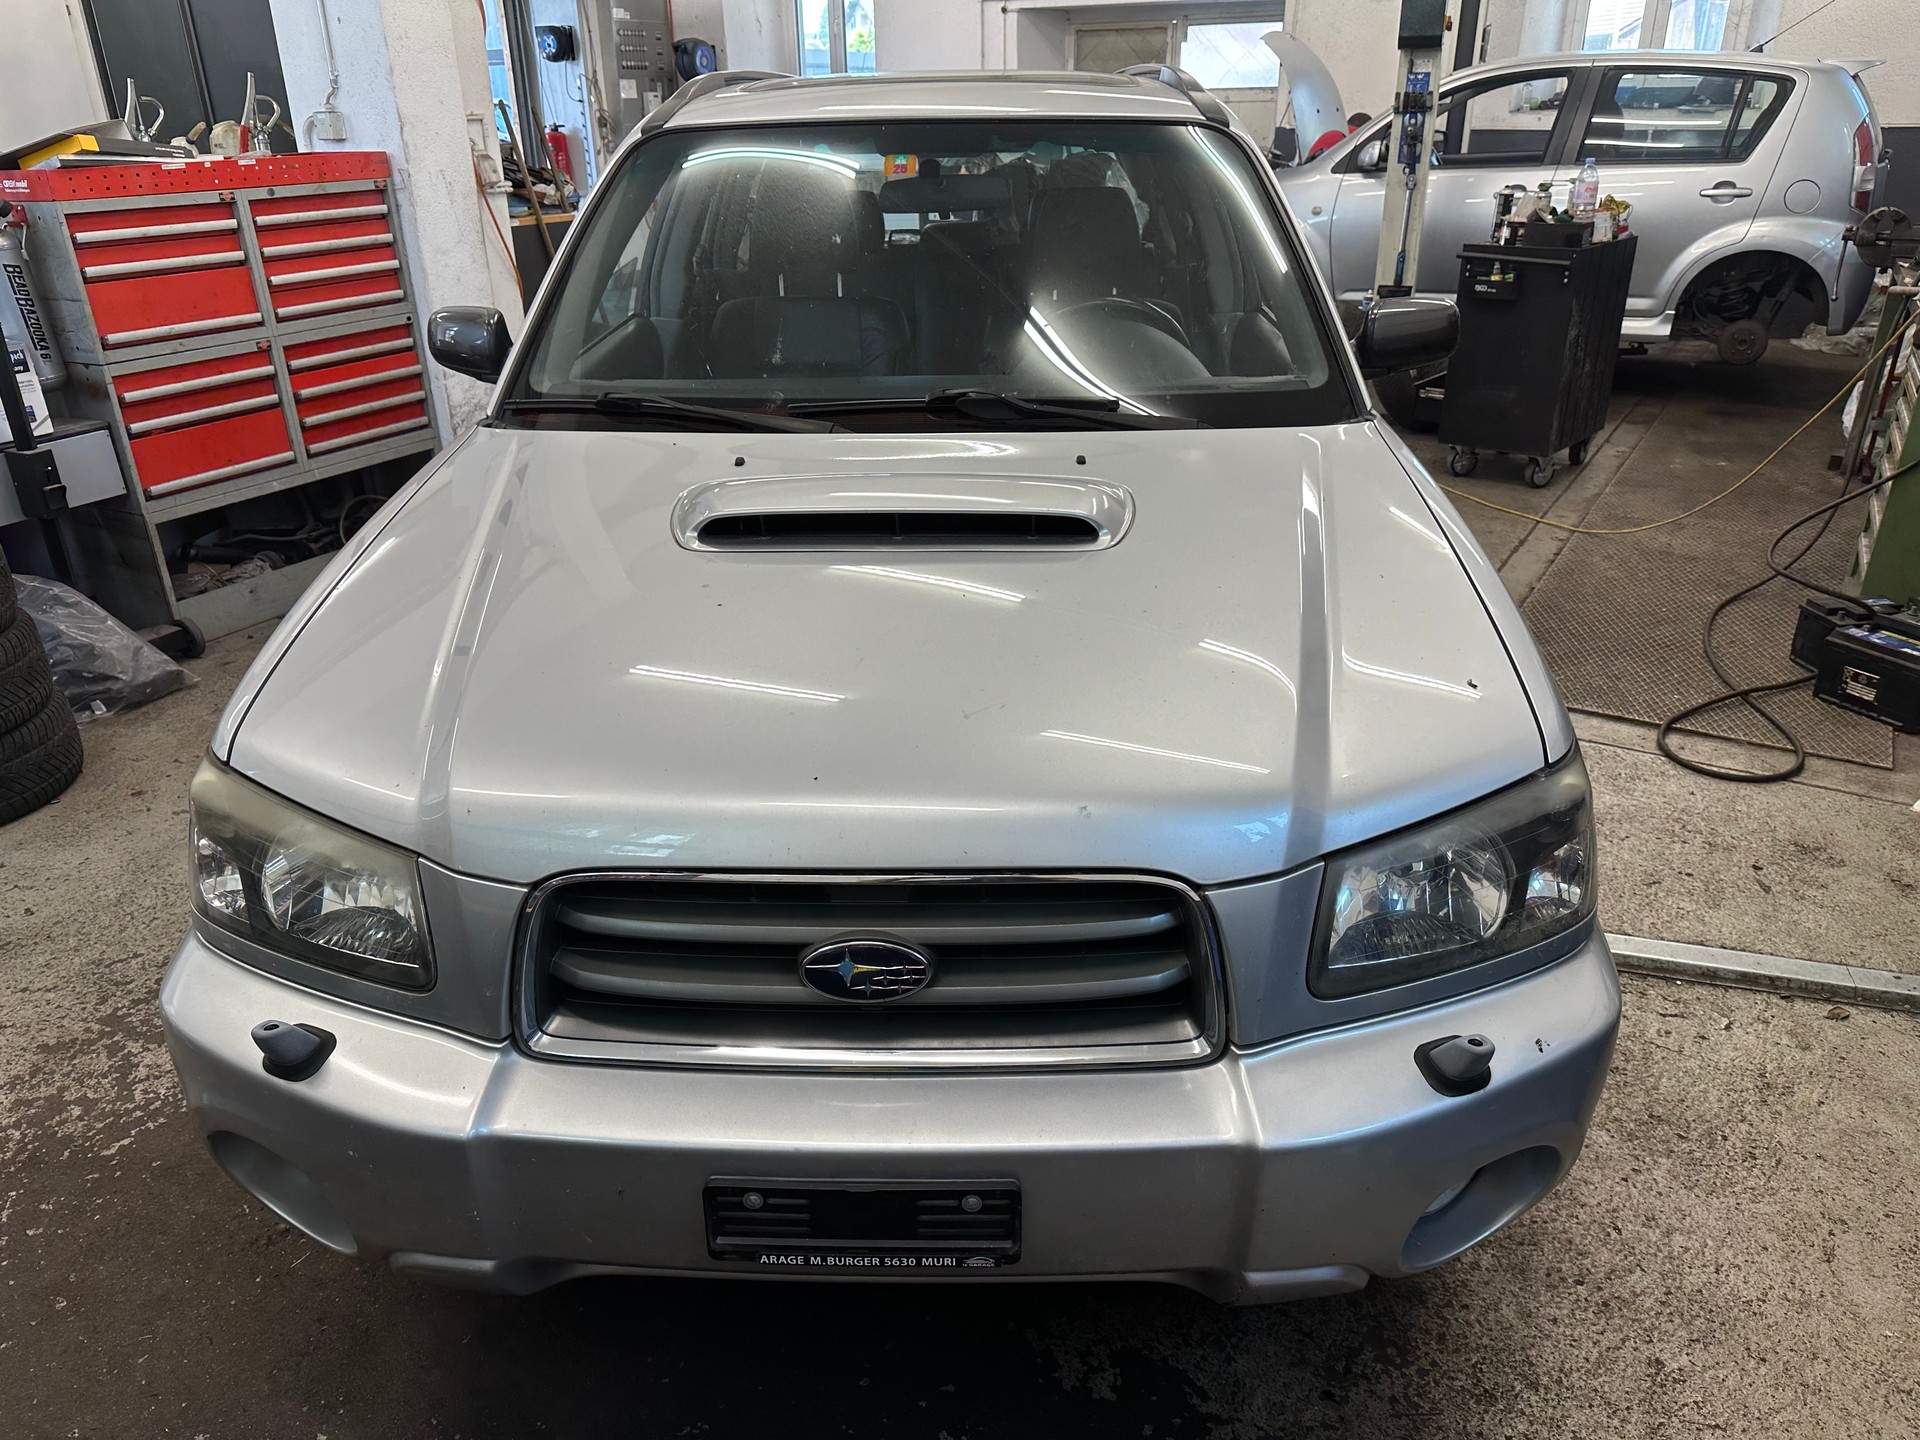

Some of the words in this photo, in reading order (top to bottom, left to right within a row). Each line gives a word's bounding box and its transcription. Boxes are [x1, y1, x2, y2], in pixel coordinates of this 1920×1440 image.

[893, 164, 908, 174] 25
[810, 1256, 880, 1266] M.BURGER
[884, 1257, 916, 1266] 5630
[921, 1257, 956, 1266] MURI
